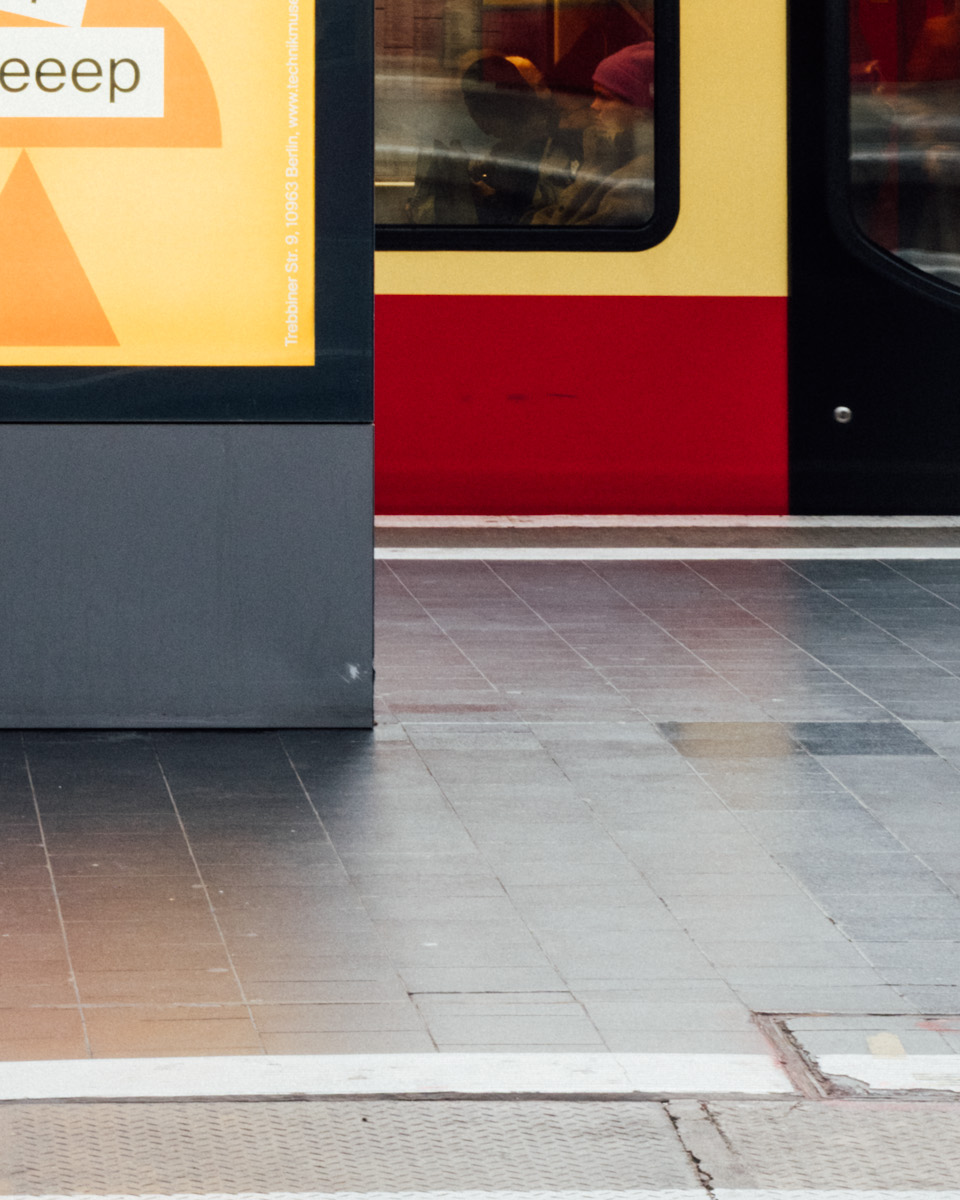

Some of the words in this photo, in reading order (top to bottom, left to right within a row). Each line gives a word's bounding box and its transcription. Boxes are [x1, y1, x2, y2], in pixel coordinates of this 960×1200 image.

[285, 131, 300, 178] Berlin,
[284, 181, 299, 228] 10963
[284, 231, 301, 246] 9,
[284, 249, 299, 273] Str.
[284, 276, 299, 347] Trebbiner
